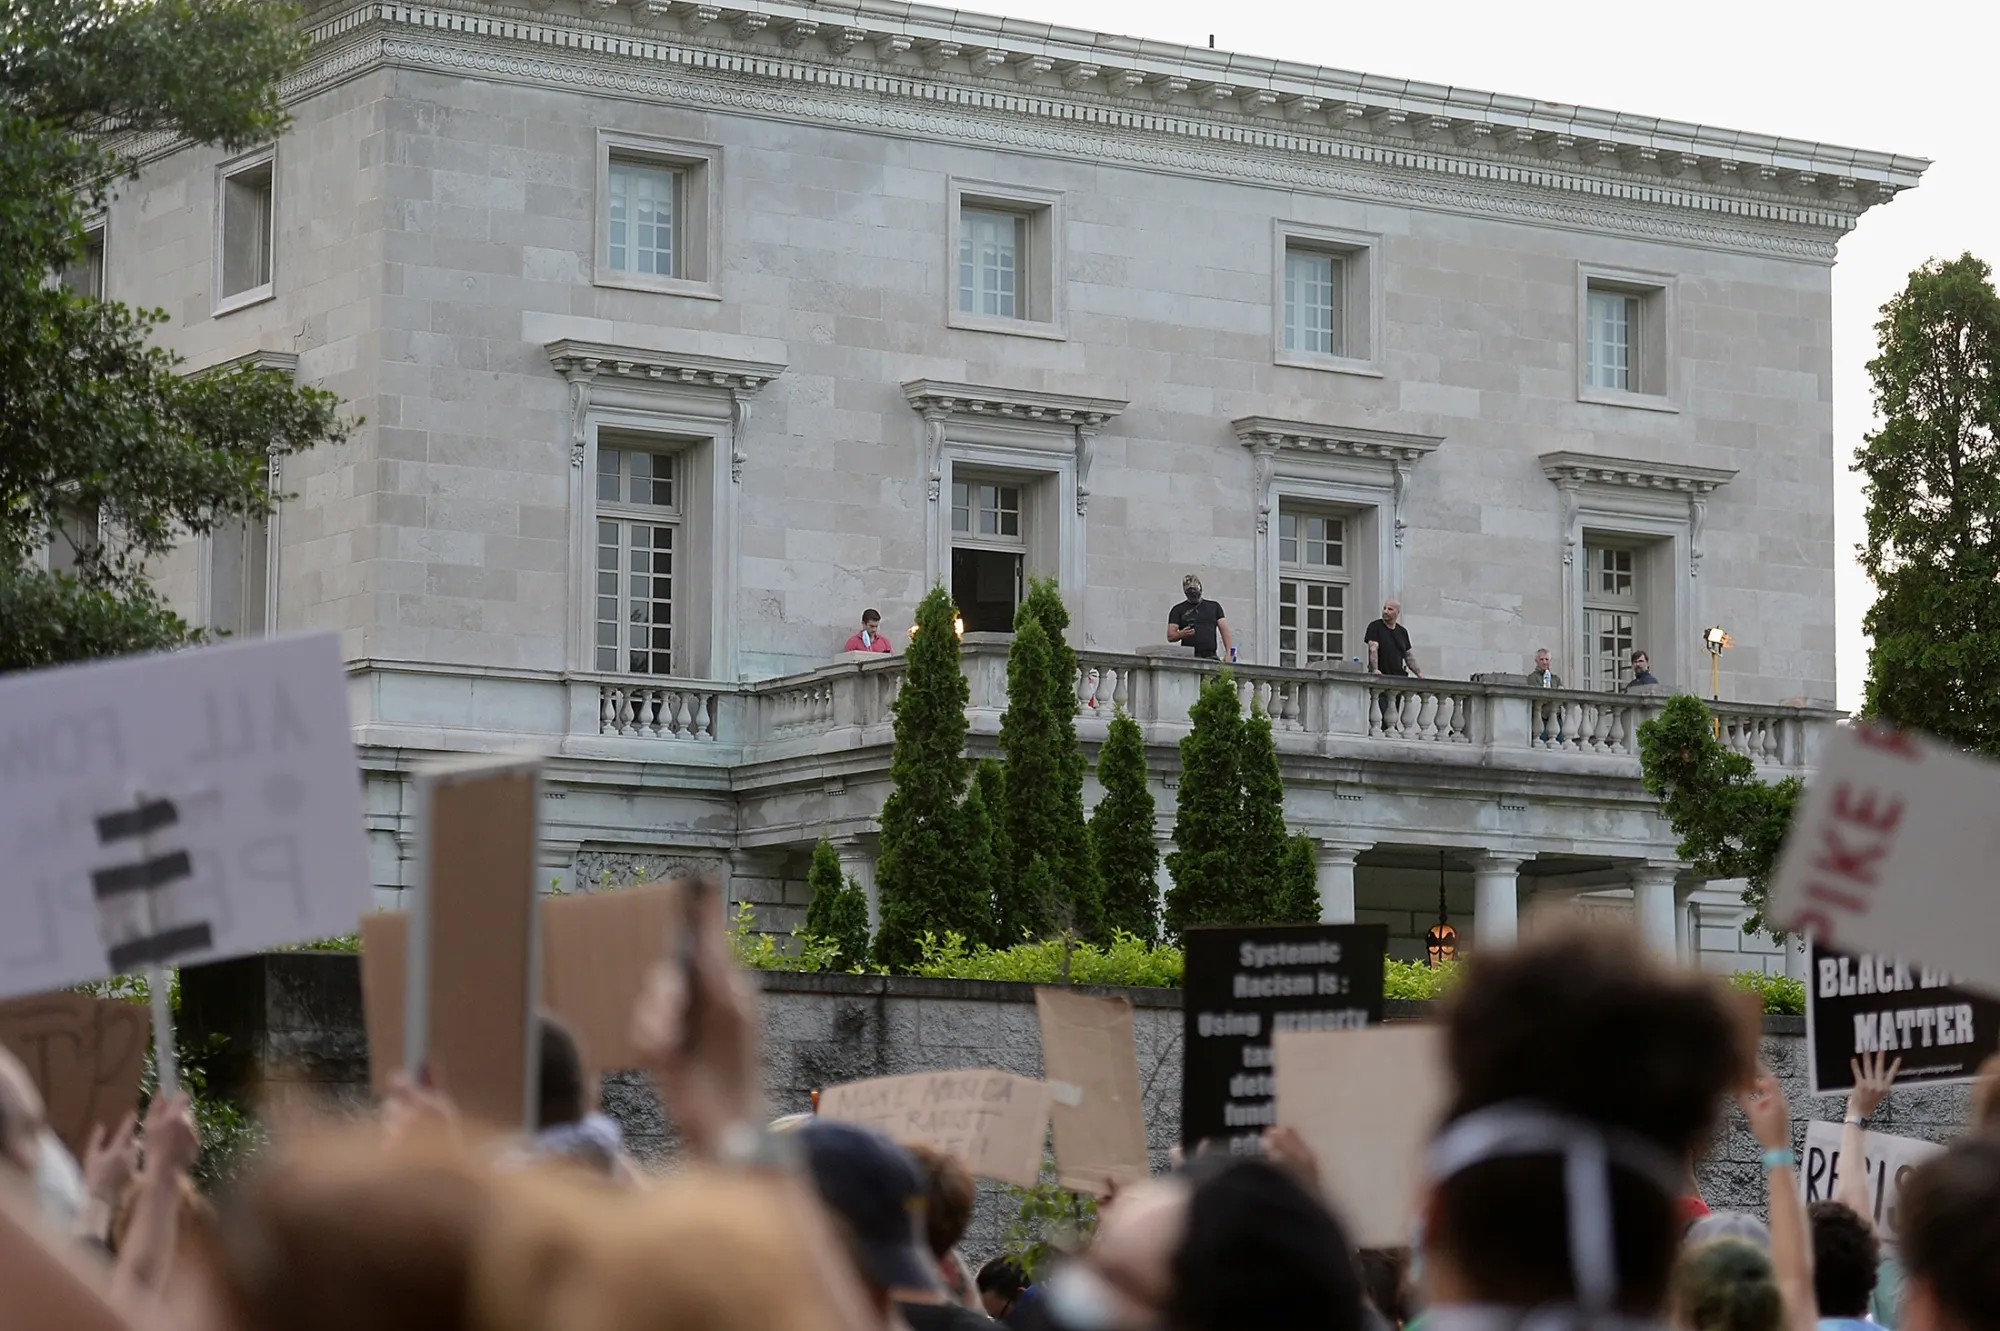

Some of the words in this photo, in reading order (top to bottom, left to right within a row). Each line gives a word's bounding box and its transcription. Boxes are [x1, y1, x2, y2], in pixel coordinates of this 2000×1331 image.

[1239, 941, 1341, 968] Systemic
[1233, 972, 1314, 998] Racism
[1818, 954, 1913, 998] BLACK
[1198, 1010, 1261, 1037] Using
[1853, 1002, 1974, 1054] MATTER
